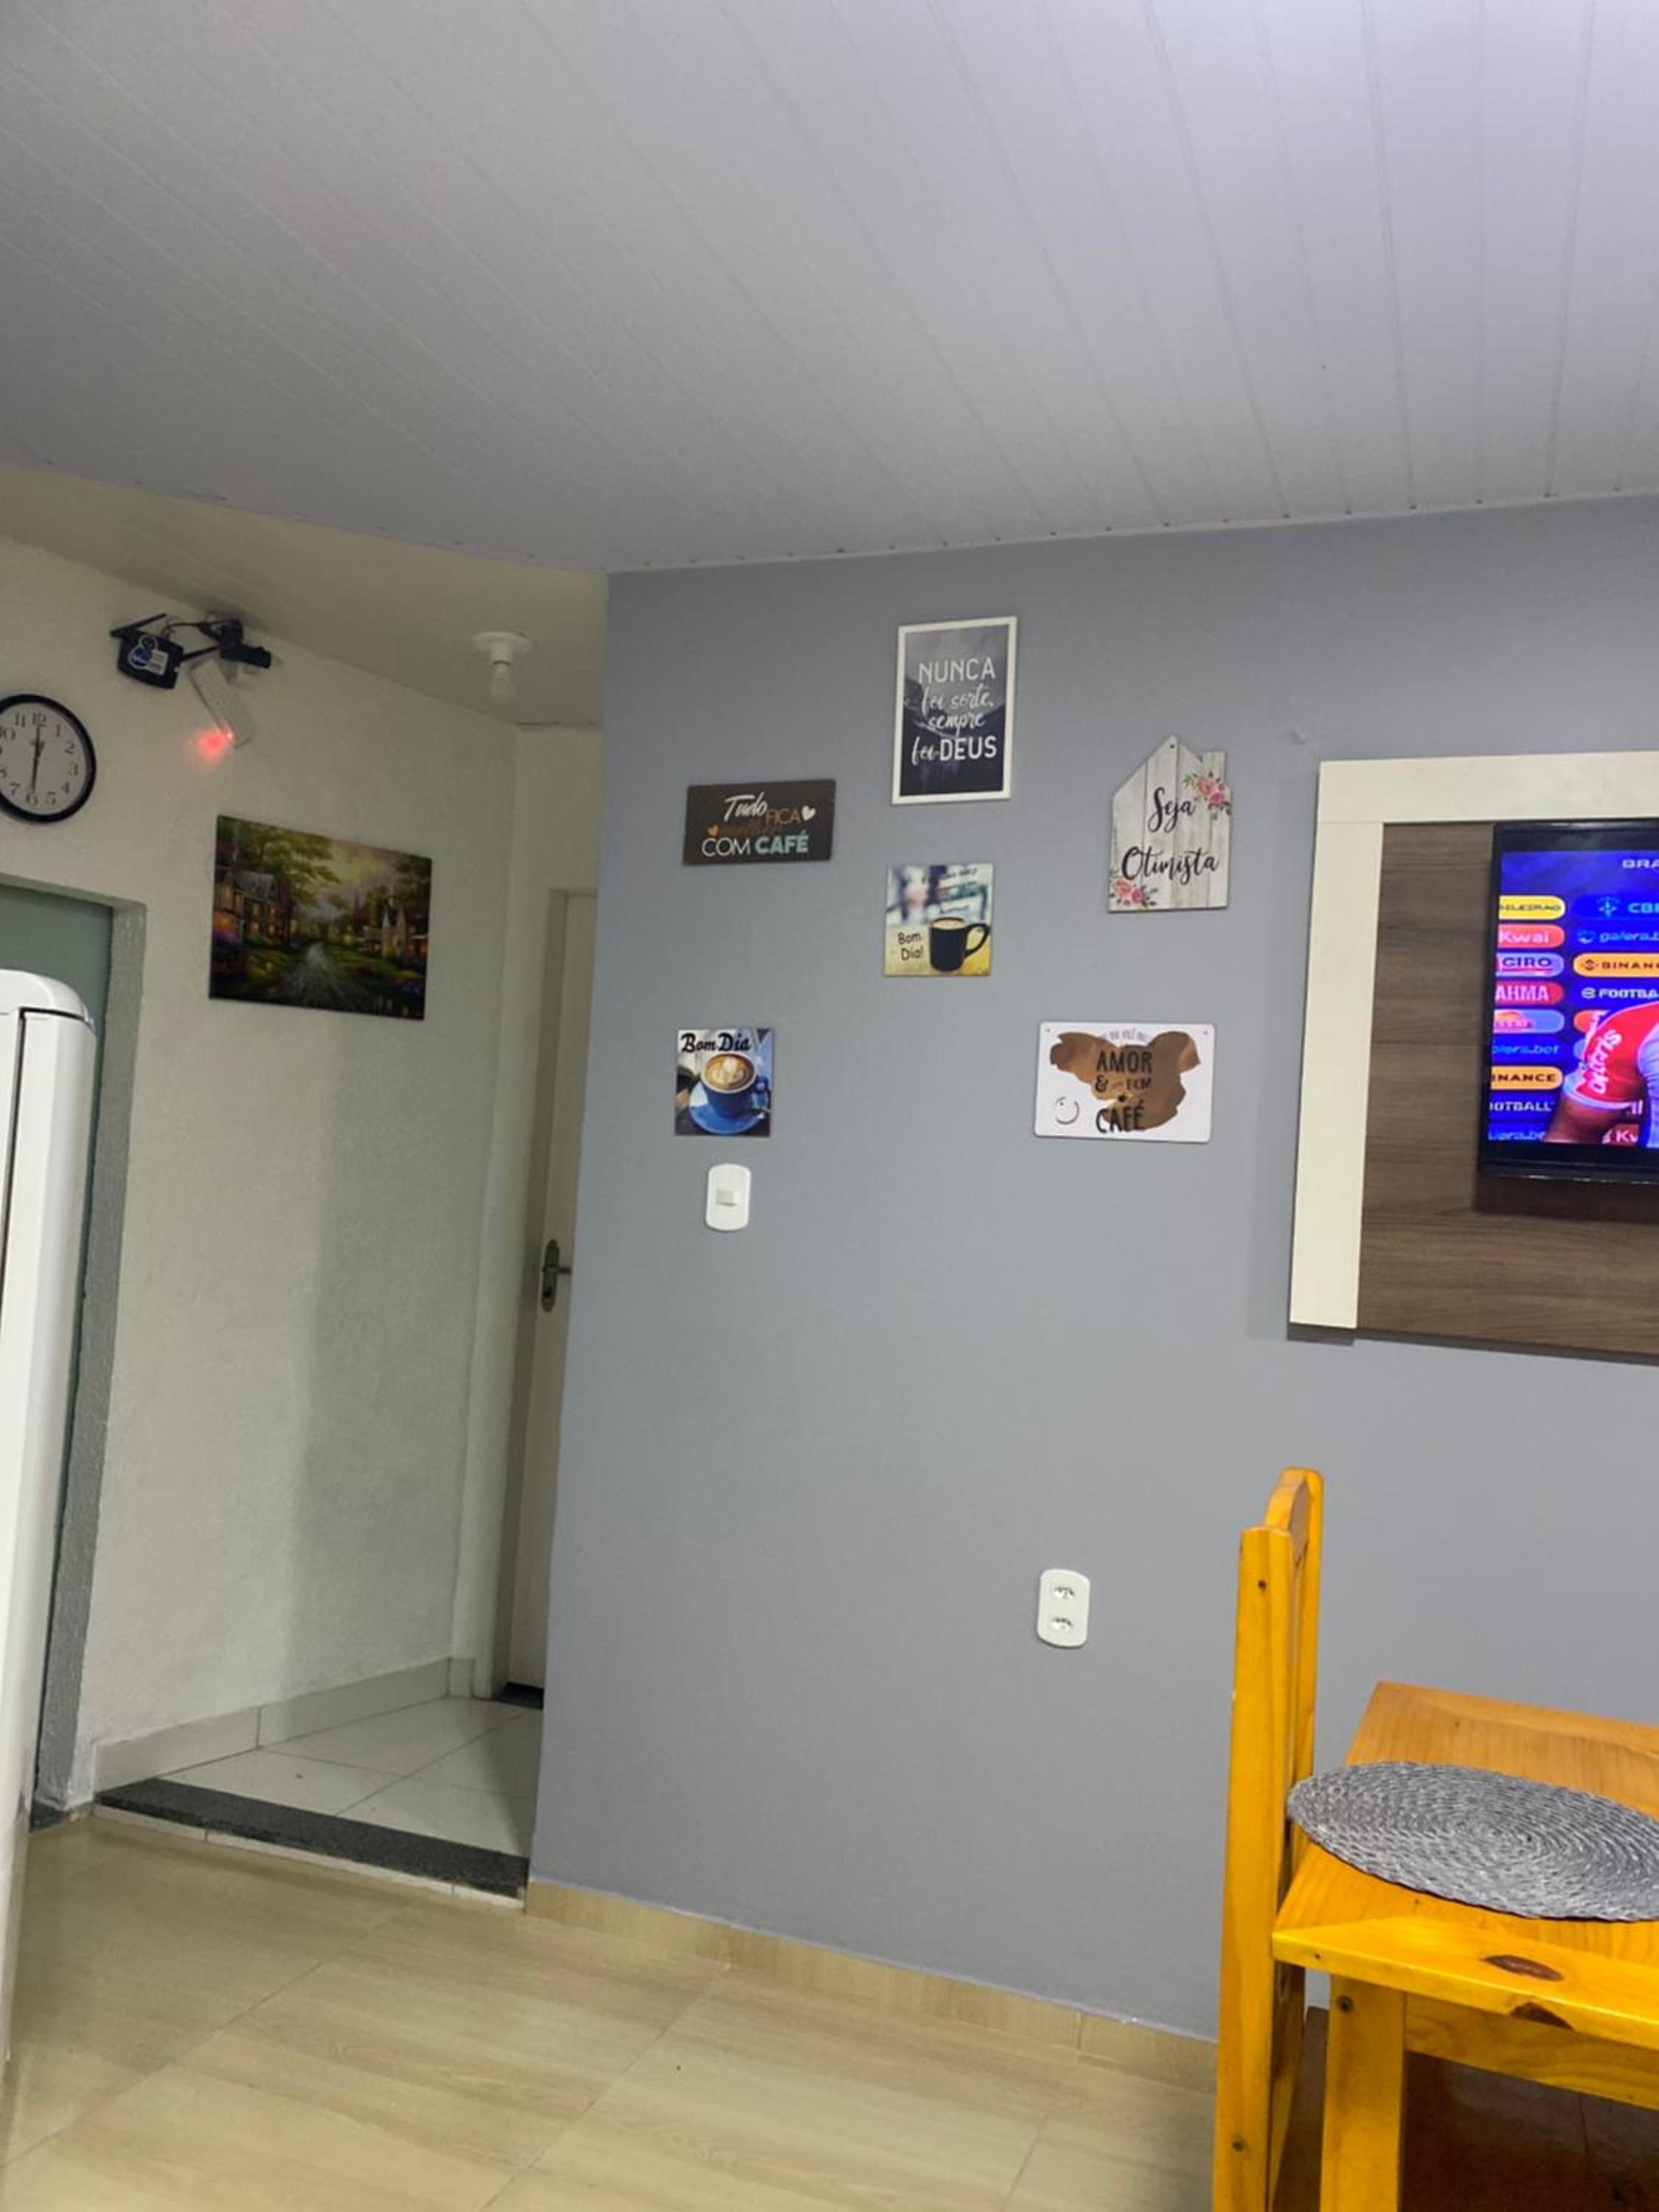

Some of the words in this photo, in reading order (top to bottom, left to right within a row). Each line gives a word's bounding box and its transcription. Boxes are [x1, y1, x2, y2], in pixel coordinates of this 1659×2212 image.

[919, 656, 995, 684] NUNCA
[928, 712, 985, 738] sempre
[939, 735, 998, 762] DEUS
[723, 791, 768, 823] Tudo
[1147, 786, 1197, 833] Seja
[701, 836, 751, 857] COM
[754, 830, 810, 855] CAFÉ
[1121, 846, 1219, 886] Otimista
[897, 931, 921, 945] Bom
[1498, 931, 1549, 943] Kwai
[681, 1032, 715, 1053] Bom
[717, 1032, 750, 1051] Dia
[1096, 1051, 1152, 1074] AMOR
[1096, 1099, 1145, 1133] CAFÉ
